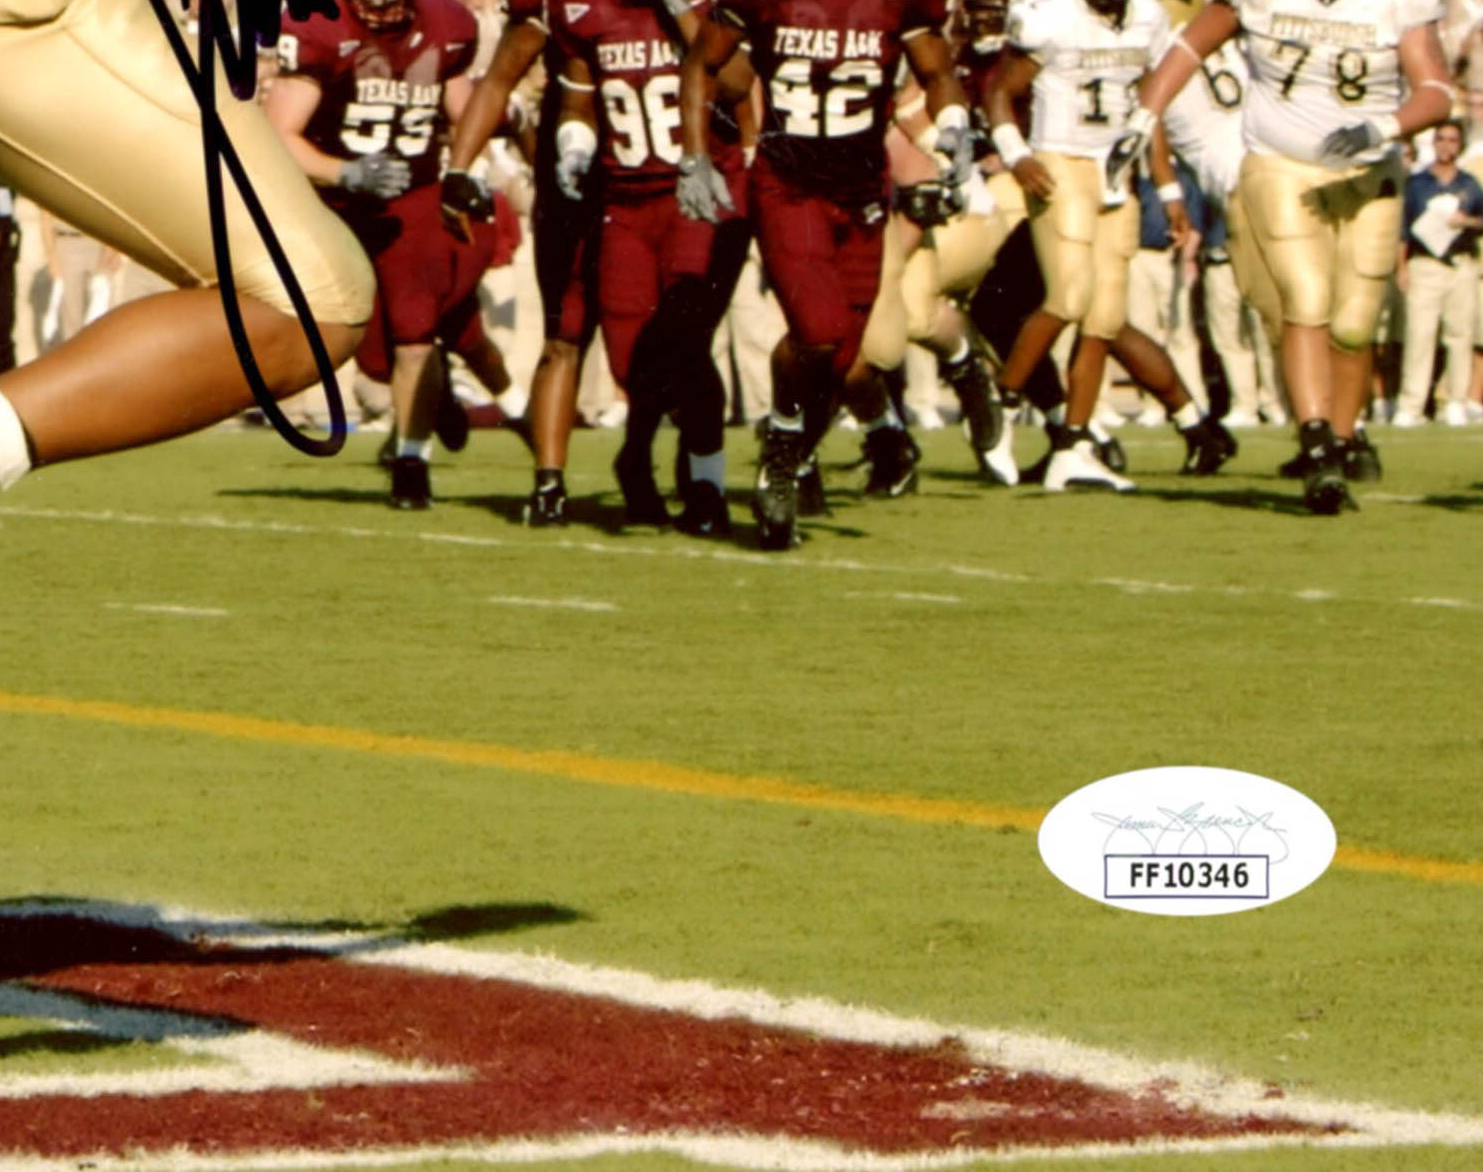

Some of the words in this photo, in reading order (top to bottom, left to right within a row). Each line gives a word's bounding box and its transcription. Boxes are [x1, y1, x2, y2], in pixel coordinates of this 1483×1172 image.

[597, 40, 648, 71] TEXAS
[649, 39, 680, 68] A&
[774, 26, 839, 60] TEXAS
[1272, 39, 1368, 103] 78
[356, 78, 408, 106] TEXAS
[770, 58, 883, 138] 42
